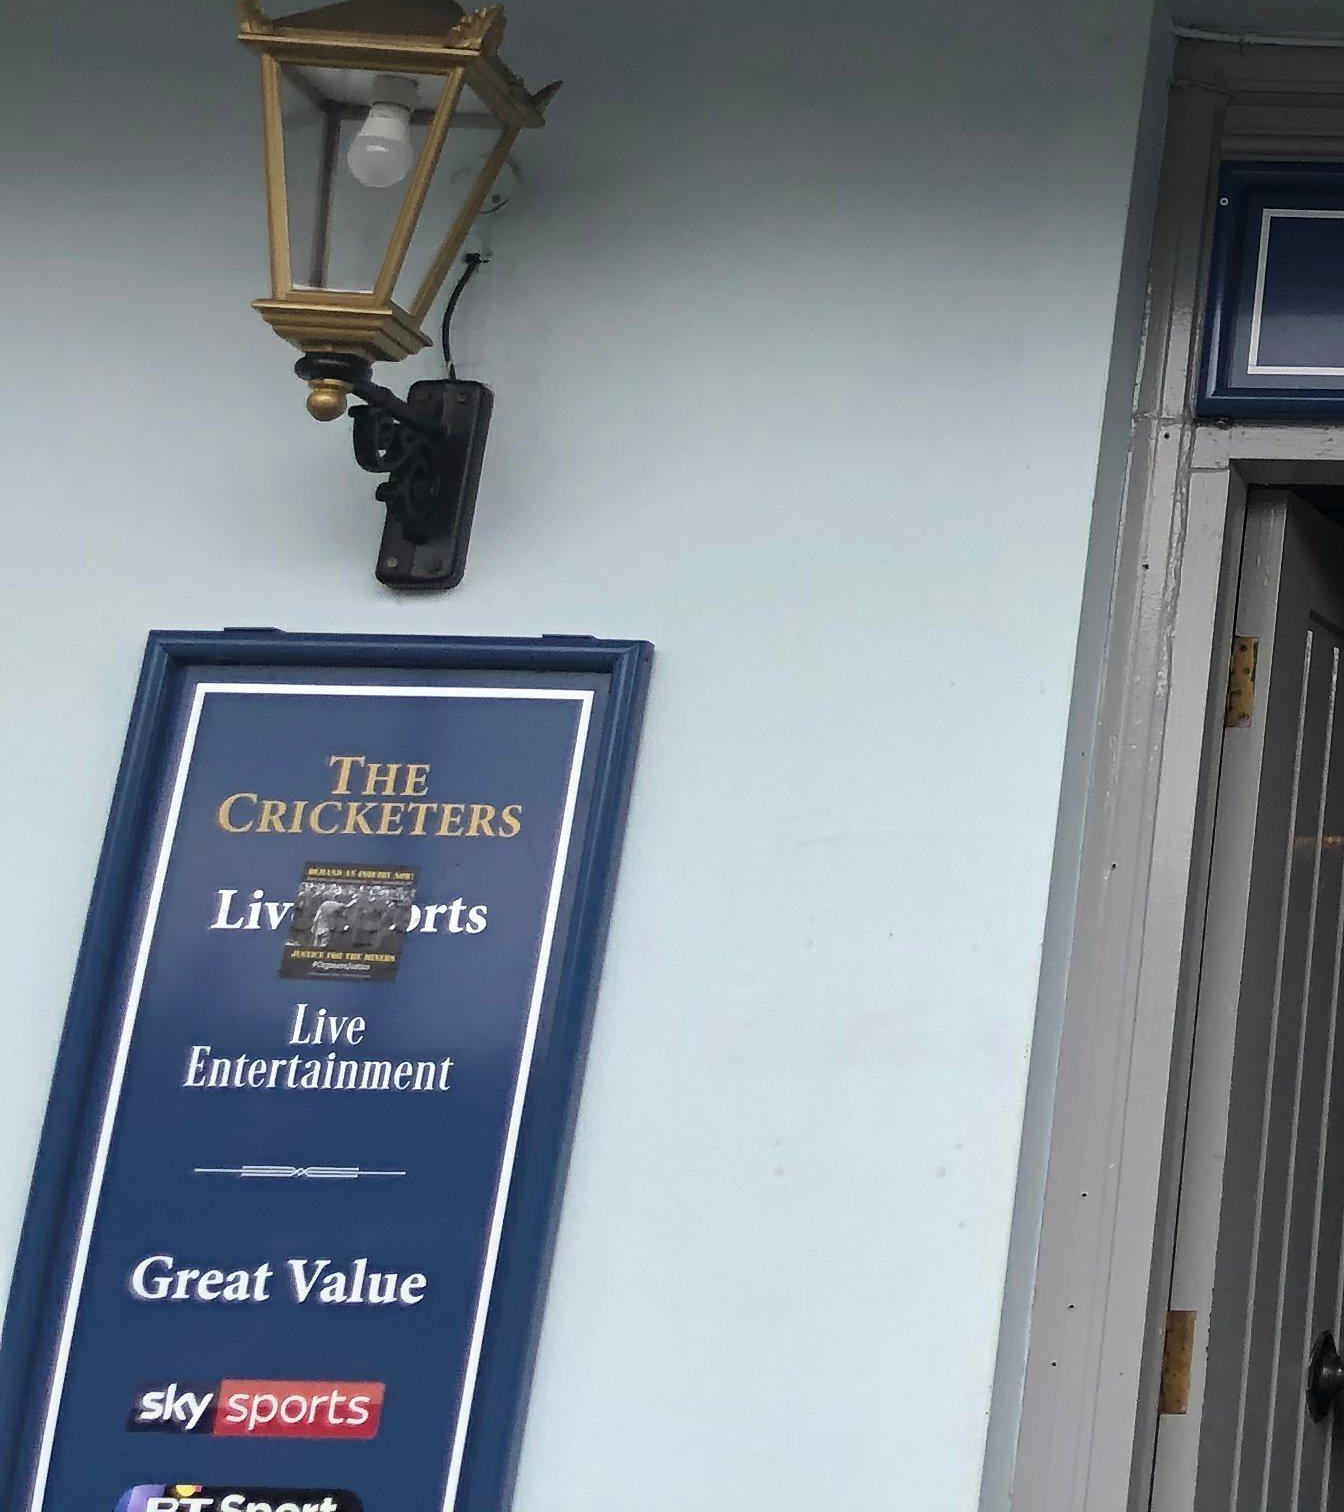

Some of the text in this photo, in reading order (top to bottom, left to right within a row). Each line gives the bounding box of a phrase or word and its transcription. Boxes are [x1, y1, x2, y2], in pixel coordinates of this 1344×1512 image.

[328, 754, 430, 797] THE
[216, 792, 523, 838] CRICKETERS
[210, 889, 298, 931] Liv
[289, 1003, 367, 1045] Live
[183, 1045, 455, 1092] Entertainment
[131, 1254, 428, 1305] Great Value
[137, 1383, 372, 1431] sky sports
